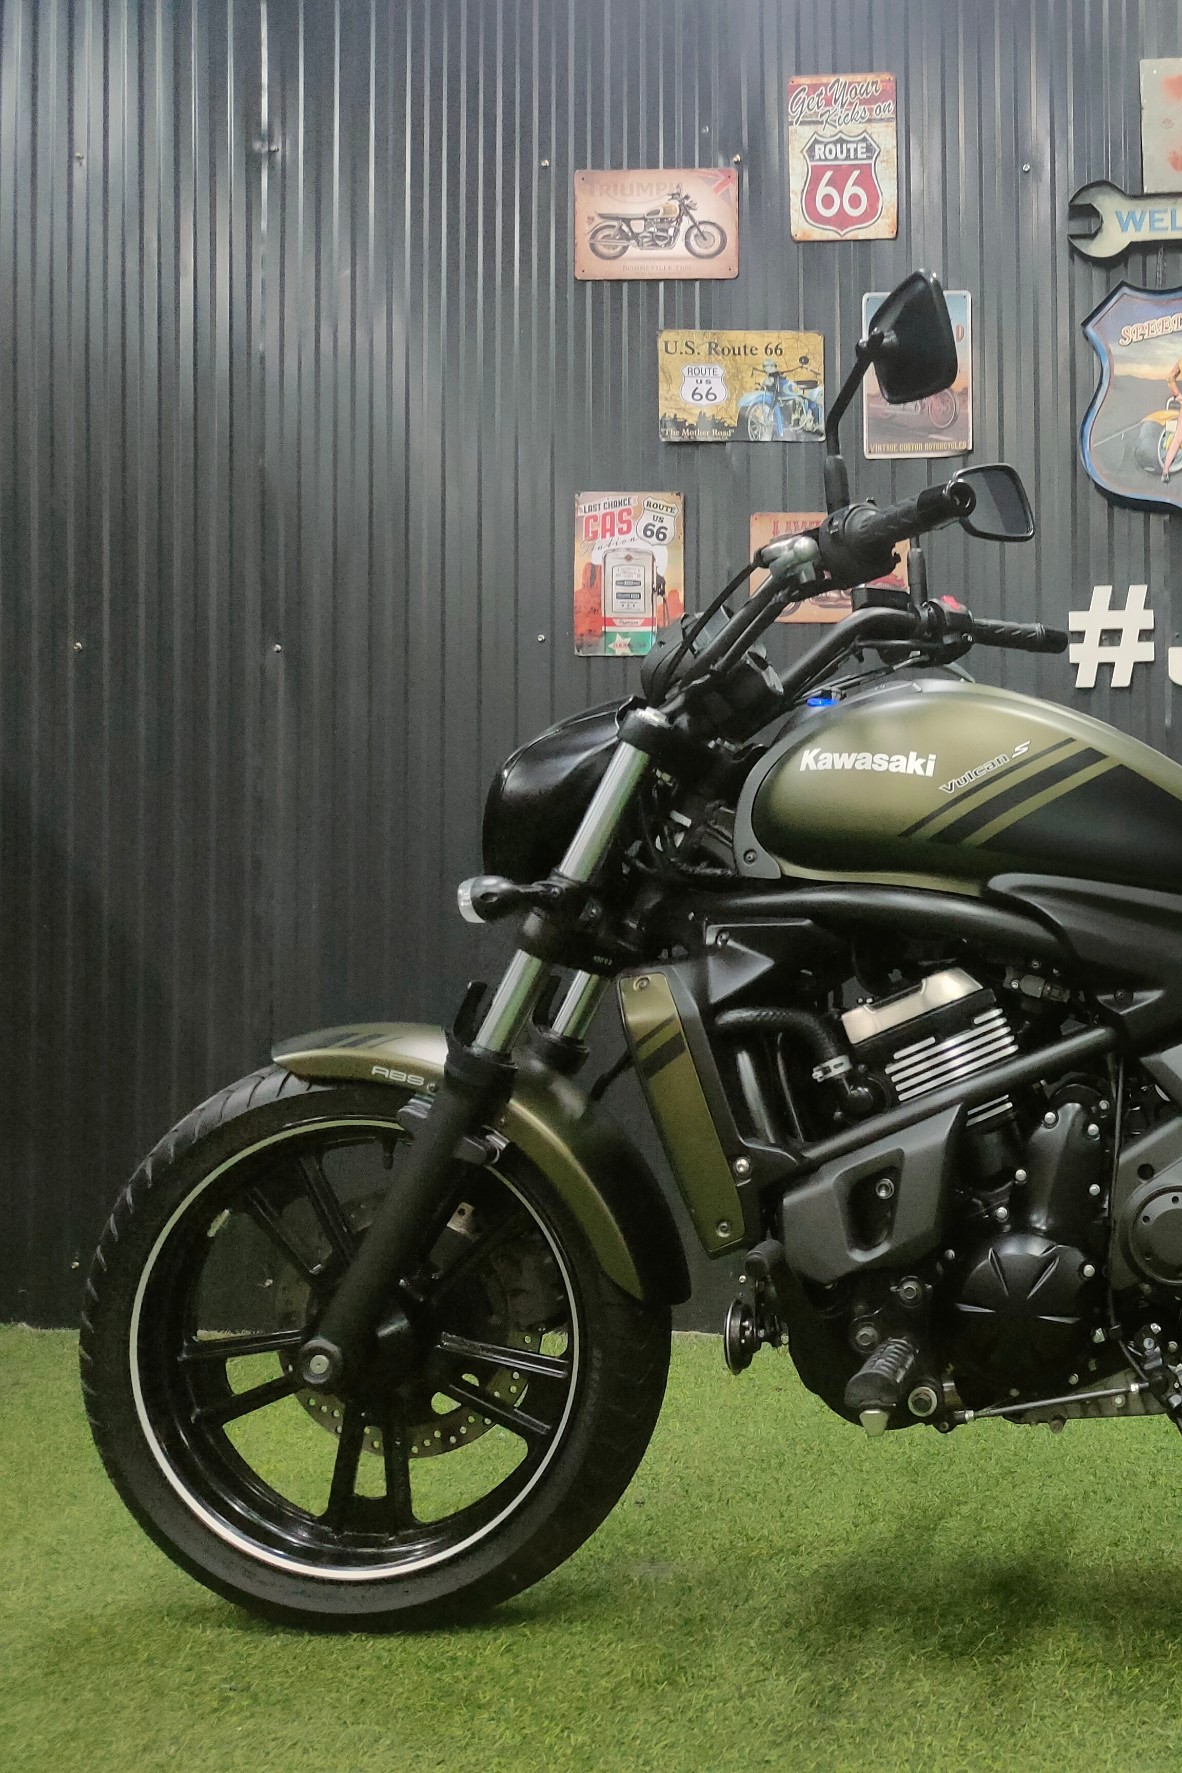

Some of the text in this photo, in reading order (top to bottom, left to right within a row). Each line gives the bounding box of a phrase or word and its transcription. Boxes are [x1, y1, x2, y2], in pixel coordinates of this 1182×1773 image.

[789, 77, 882, 126] Get Your
[819, 100, 894, 131] Kicks on
[814, 142, 867, 160] ROUTE
[815, 170, 867, 218] 66
[664, 340, 784, 357] U.S. Route 66
[687, 366, 718, 376] ROUTE
[691, 386, 718, 402] 66
[584, 498, 632, 514] LAST CHANCE
[646, 501, 676, 514] ROUTE
[584, 507, 633, 542] GAS
[652, 515, 665, 523] US
[642, 523, 668, 542] 66
[800, 748, 936, 777] Kawasaki
[938, 740, 1031, 794] Vulcan S
[371, 1065, 424, 1086] ABS
